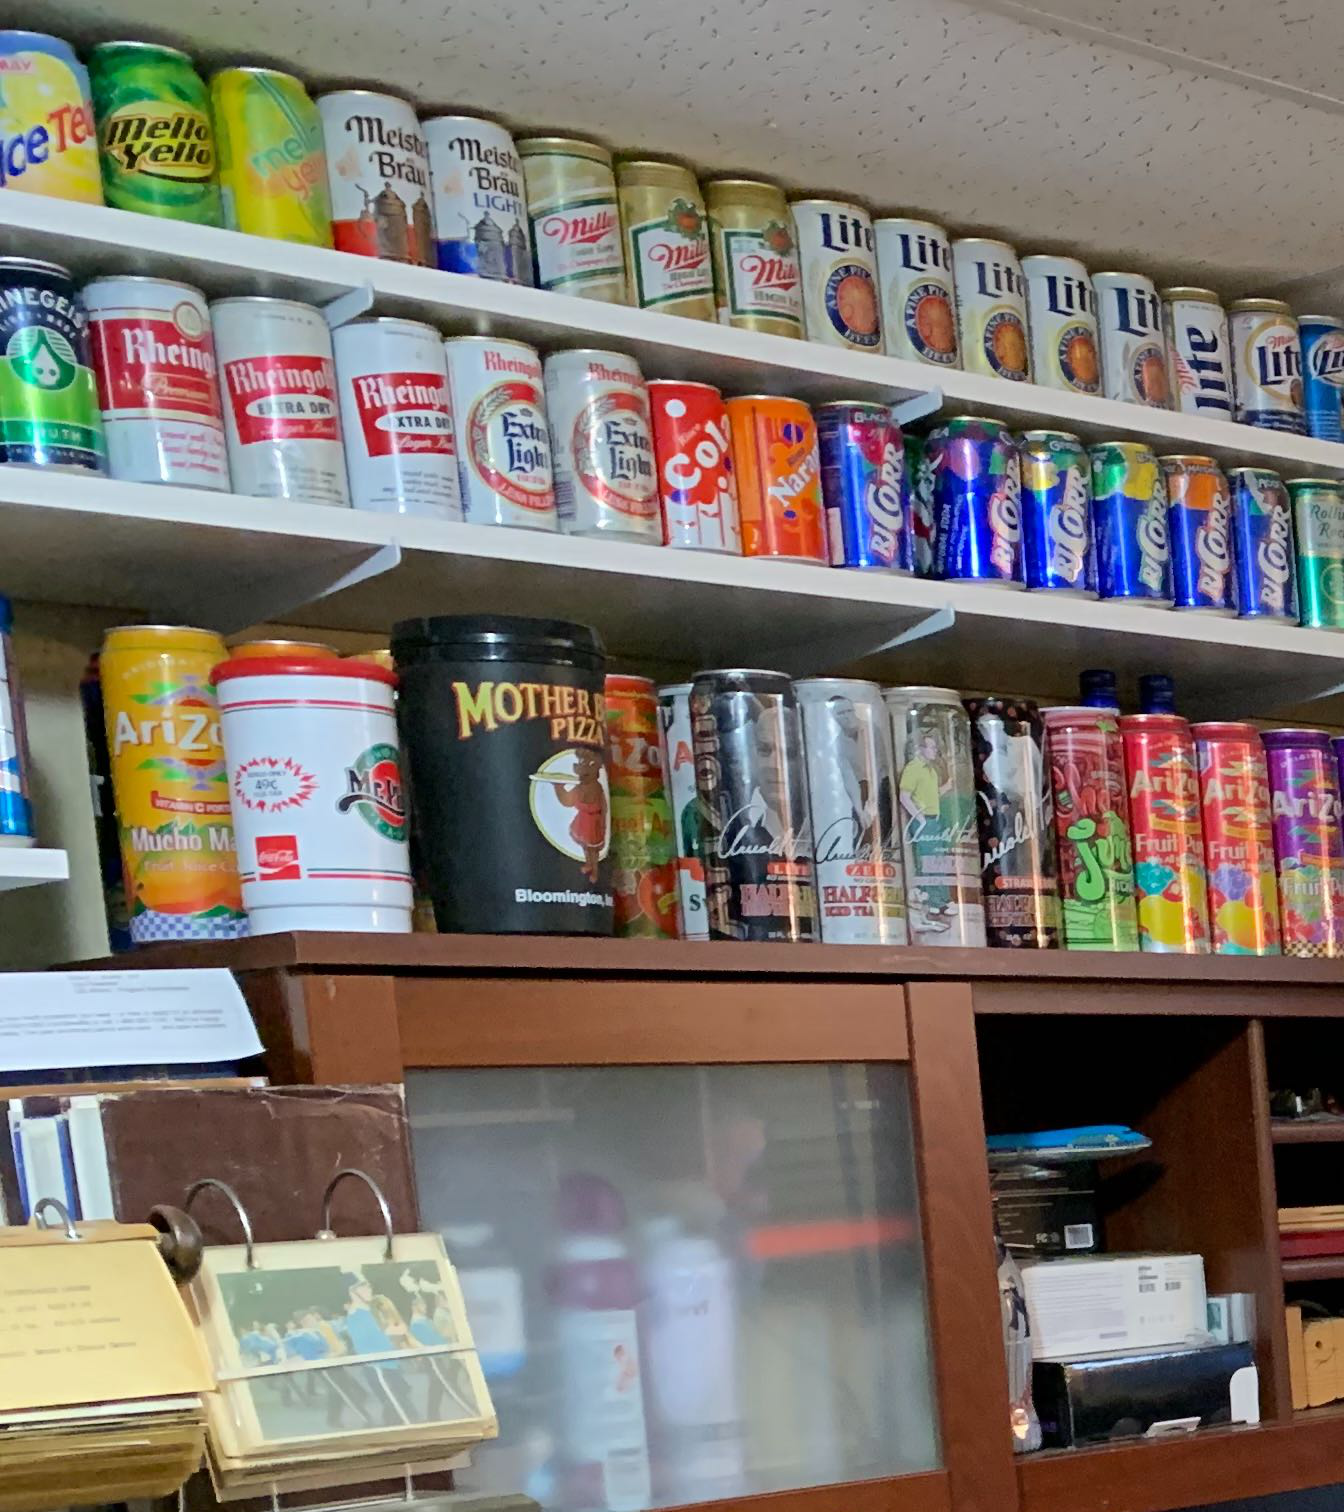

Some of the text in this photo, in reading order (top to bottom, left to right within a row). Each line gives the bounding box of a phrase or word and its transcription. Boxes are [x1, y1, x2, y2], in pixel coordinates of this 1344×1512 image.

[105, 114, 211, 147] Mello
[124, 140, 212, 170] Yello
[1185, 325, 1232, 415] Lite
[385, 415, 431, 429] XTRA
[453, 681, 590, 741] MOTHER
[551, 716, 605, 746] PIZZA
[131, 826, 203, 853] Mucho
